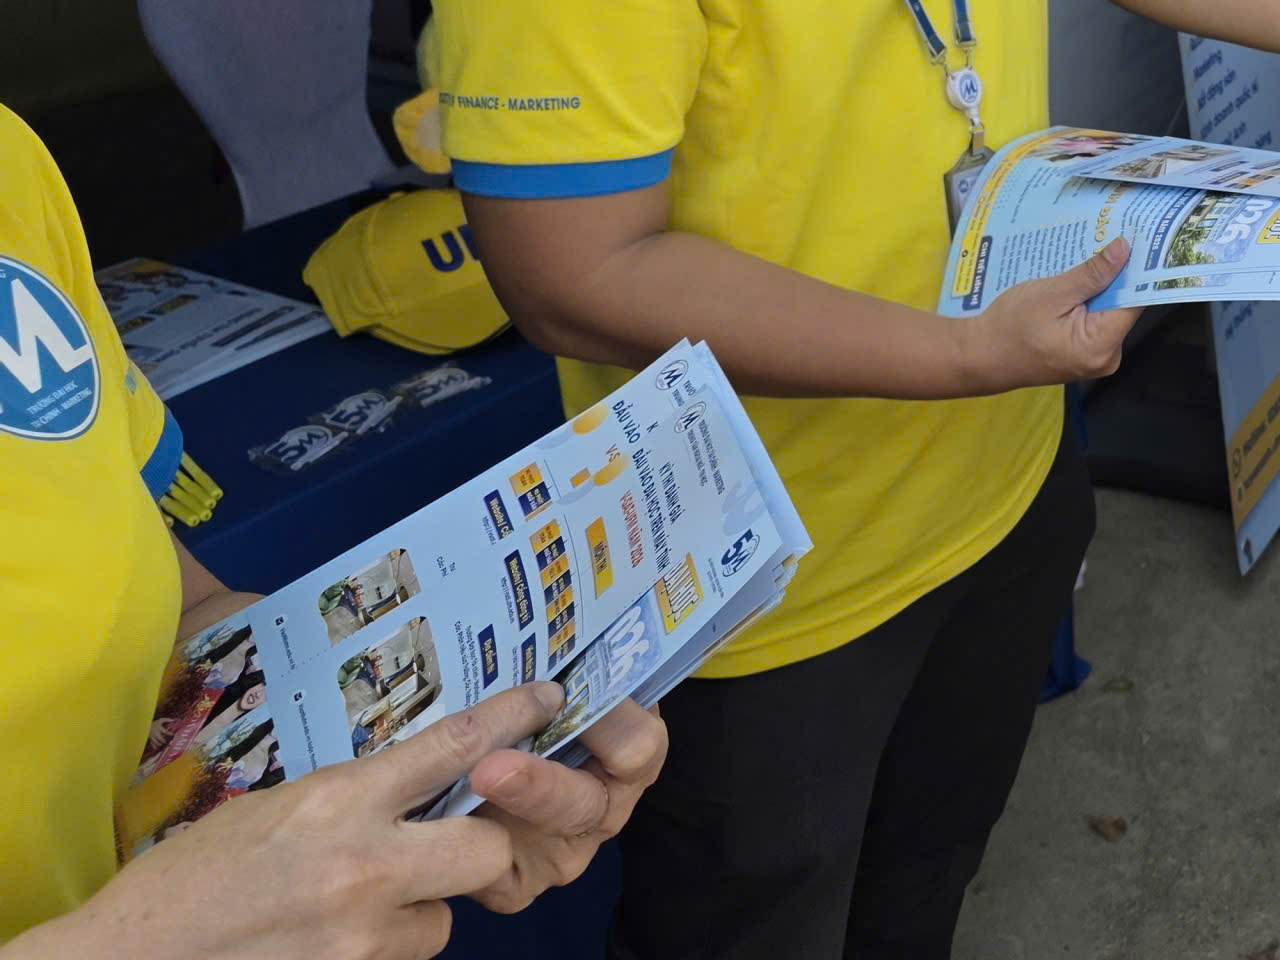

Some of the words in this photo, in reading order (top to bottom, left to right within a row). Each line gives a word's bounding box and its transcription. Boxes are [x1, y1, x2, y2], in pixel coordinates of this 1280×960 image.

[457, 95, 499, 111] FINANCE
[508, 96, 582, 112] MARKETING
[978, 241, 988, 258] CHI
[975, 259, 986, 274] TIẾT
[972, 275, 983, 293] LIÊN
[968, 294, 978, 305] HỆ
[63, 387, 92, 411] MARKETING
[672, 387, 683, 406] TRUNG
[612, 397, 630, 422] ĐẦU
[623, 418, 640, 443] VÀO
[647, 422, 658, 432] K
[633, 447, 648, 468] ĐẦU
[638, 465, 652, 485] VÀO
[658, 461, 674, 475] KỲ
[661, 472, 673, 488] THI
[643, 483, 654, 501] ĐẠI
[664, 483, 678, 509] ĐÁNH
[489, 497, 507, 527] Website/
[646, 498, 659, 517] HỌC
[669, 504, 684, 523] GIÁ
[650, 512, 663, 536] TRÊN
[628, 526, 640, 546] NĂM
[653, 531, 666, 552] MÁY
[593, 540, 606, 561] MÔN
[631, 544, 642, 567] 2026
[656, 548, 670, 572] TÍNH
[509, 557, 522, 584] Website/
[596, 557, 608, 575] THI
[671, 581, 702, 623] HỌC
[483, 638, 491, 650] Địa
[486, 649, 494, 667] điểm
